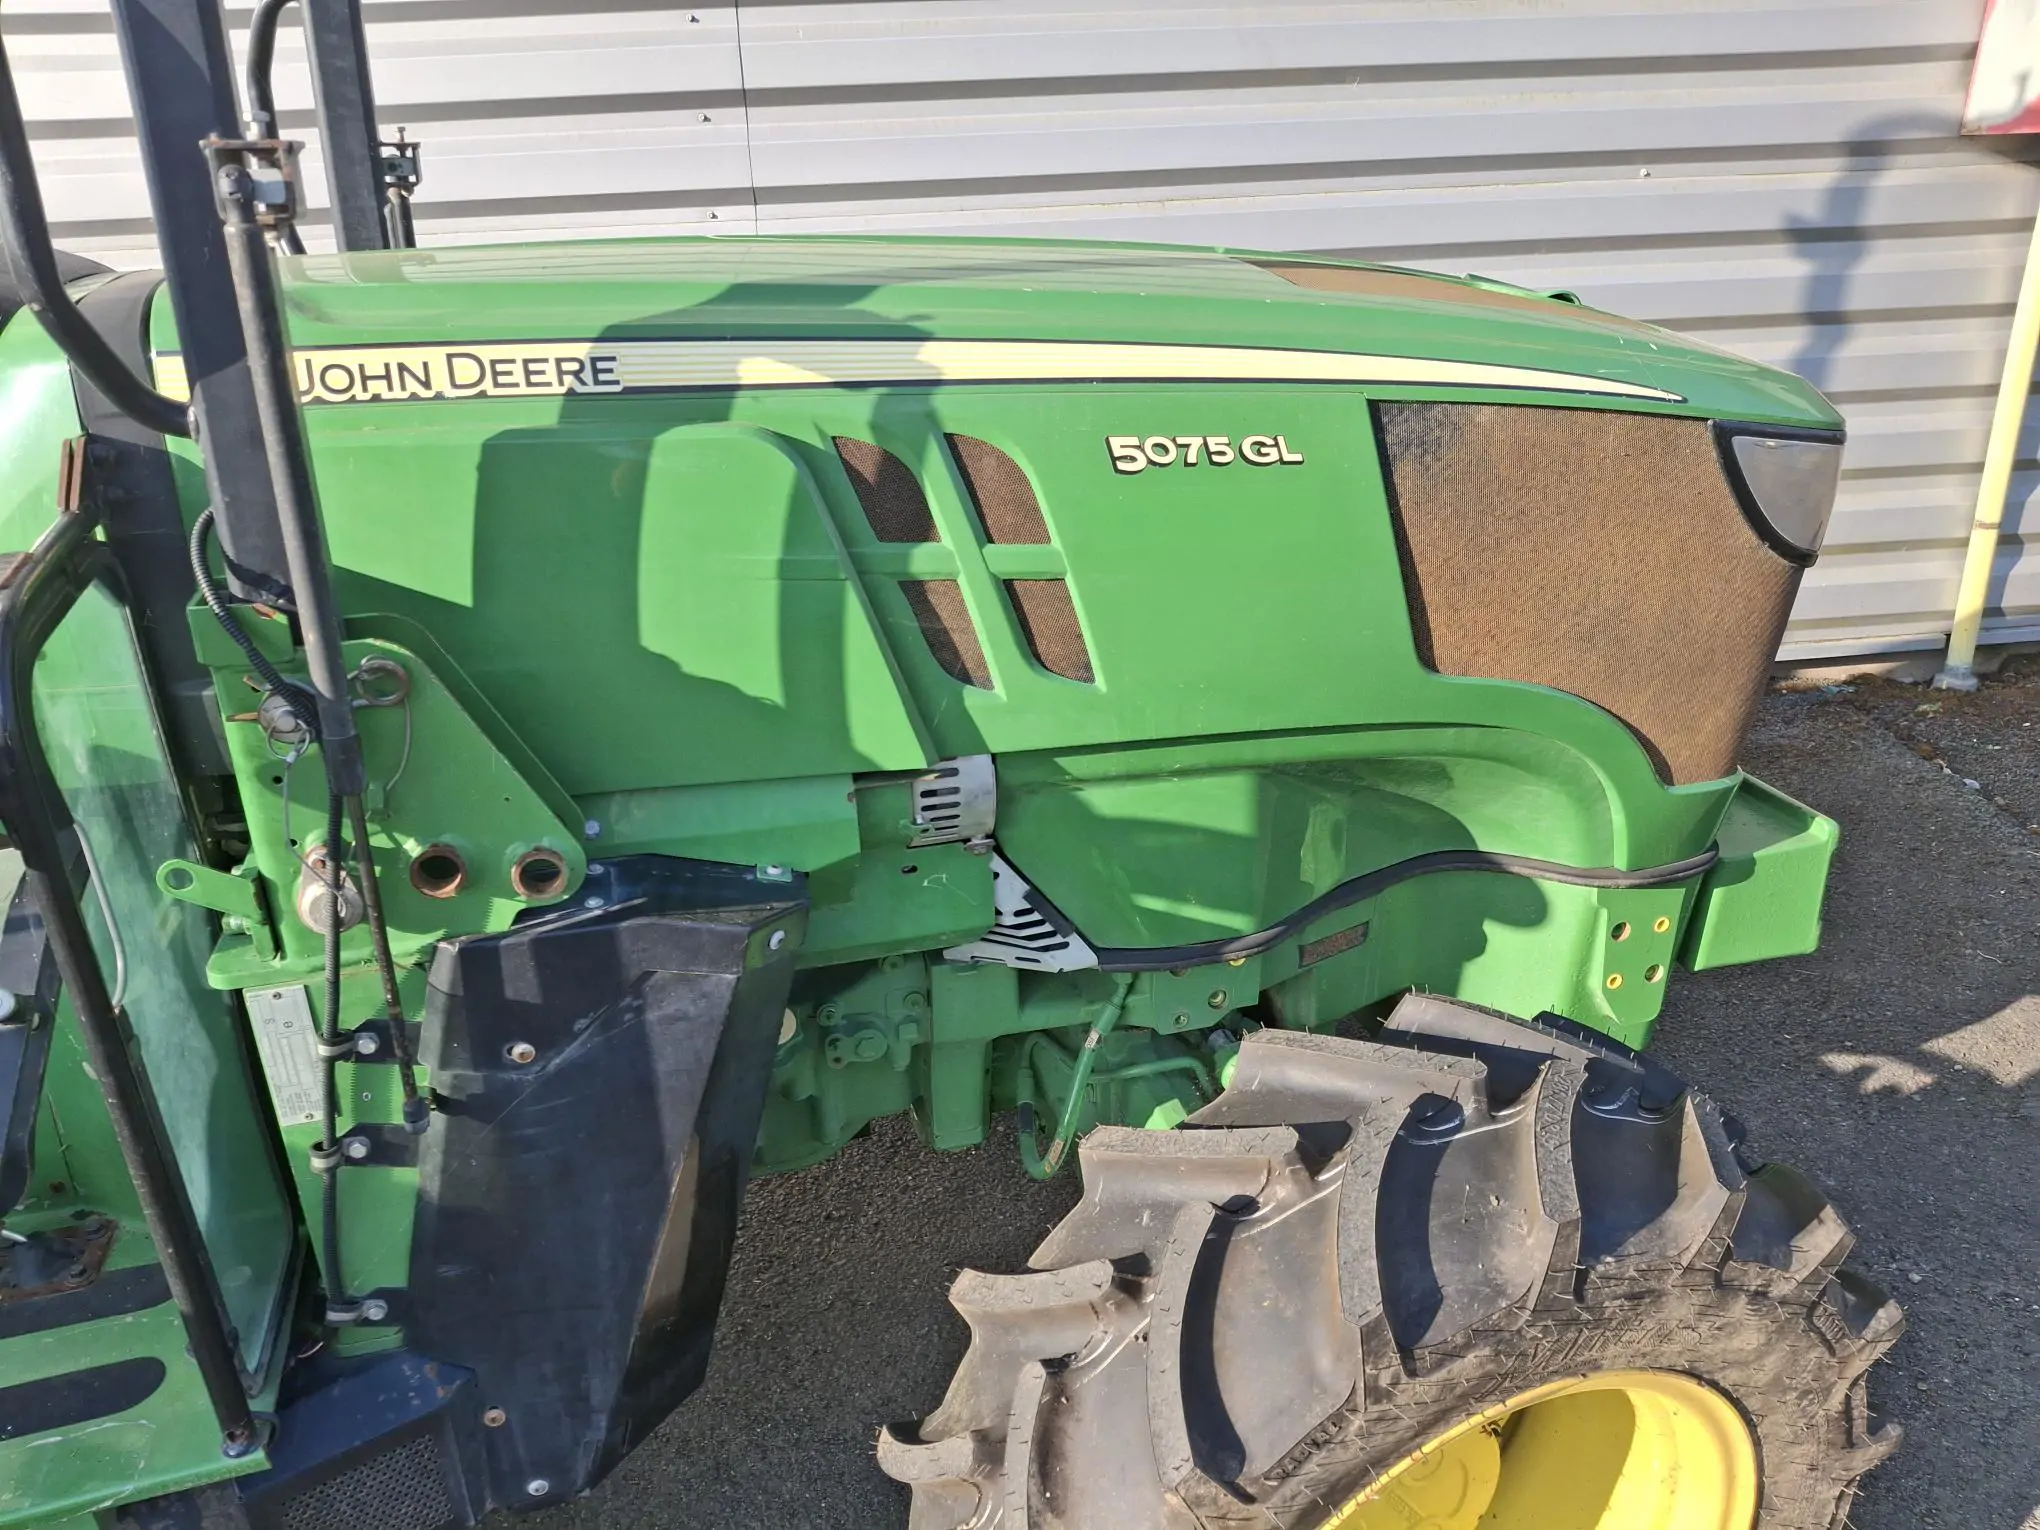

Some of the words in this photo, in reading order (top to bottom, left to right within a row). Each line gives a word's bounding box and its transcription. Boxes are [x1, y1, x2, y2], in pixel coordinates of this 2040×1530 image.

[300, 358, 433, 394] JOHN
[445, 352, 621, 391] DEERE
[1105, 435, 1236, 475] 5075
[1239, 434, 1305, 466] GL
